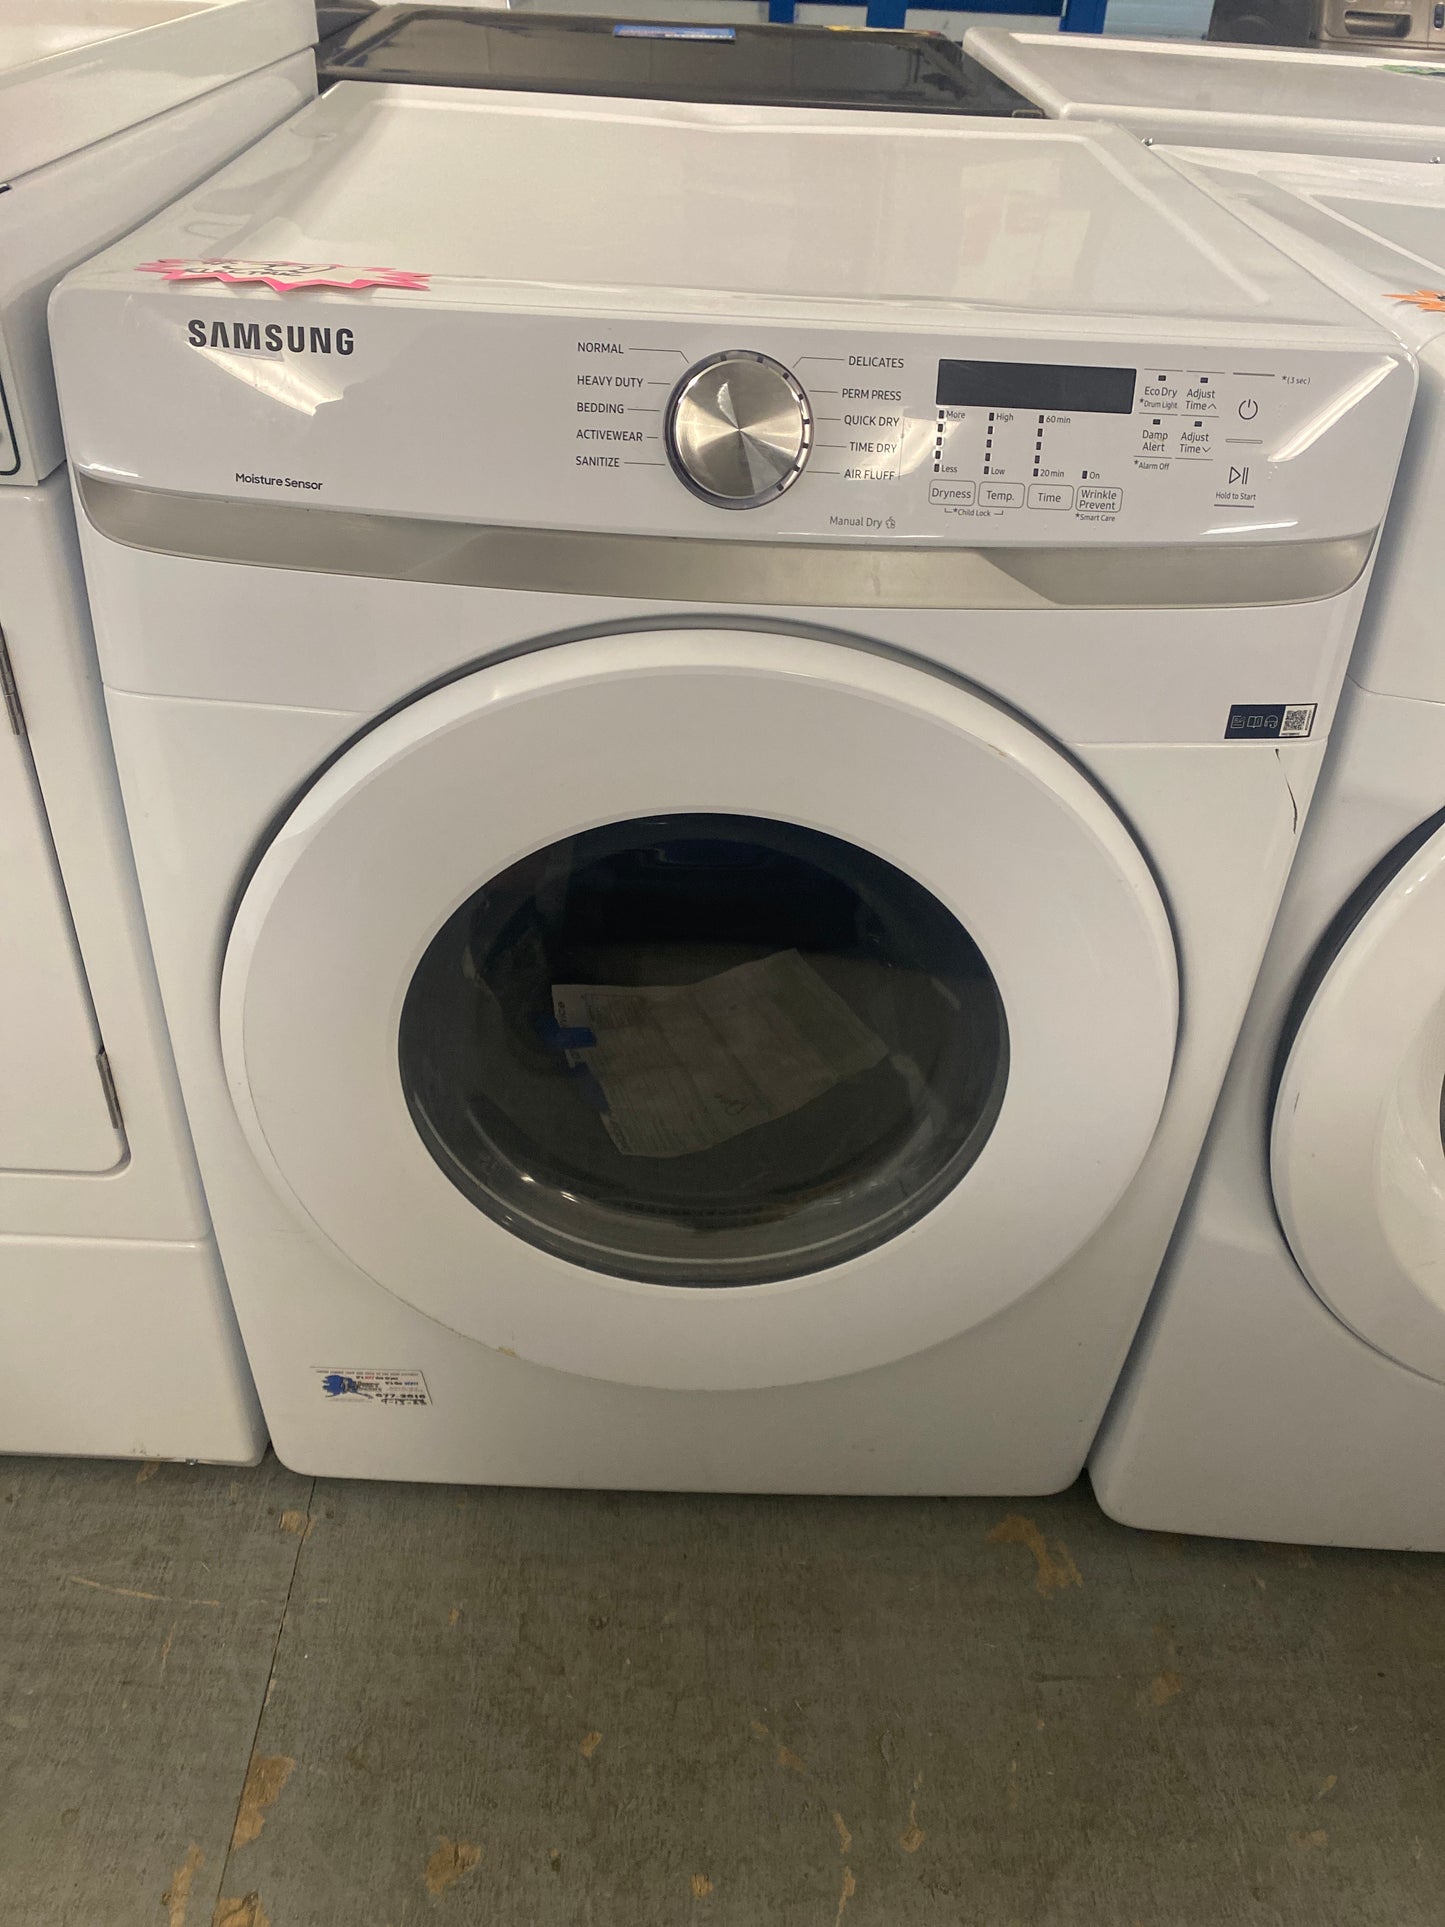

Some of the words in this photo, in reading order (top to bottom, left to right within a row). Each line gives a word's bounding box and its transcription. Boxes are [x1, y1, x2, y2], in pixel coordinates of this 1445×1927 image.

[188, 319, 354, 355] SAMSUNG
[577, 342, 624, 354] NORMAL
[848, 355, 905, 369] DELICATES
[576, 375, 613, 386] HEAVY
[615, 376, 644, 388] DUTY
[841, 388, 870, 400] PERM
[871, 390, 902, 401] PRESS
[1144, 386, 1160, 397] Eco
[1161, 387, 1178, 399] Dry
[1186, 388, 1216, 400] Adjust
[576, 402, 625, 414] BEDDING
[1162, 400, 1178, 410] Light
[1185, 400, 1207, 411] Time
[844, 414, 877, 426] QUICK
[878, 416, 900, 427] DRY
[945, 410, 966, 420] More
[996, 413, 1014, 423] High
[1045, 415, 1057, 424] 60
[1058, 416, 1071, 424] min
[576, 429, 643, 442] ACTIVEWEAR
[1142, 429, 1168, 442] Damp
[1180, 431, 1209, 443] Adjust
[849, 441, 874, 453] TIME
[876, 443, 897, 454] DRY
[1142, 441, 1165, 452] Alert
[1179, 443, 1201, 454] Time
[575, 456, 620, 468] SANITIZE
[1159, 462, 1170, 471] Off
[843, 468, 862, 480] AIR
[864, 469, 896, 481] FLUFF
[941, 464, 958, 474] Less
[991, 467, 1006, 475] Low
[1040, 468, 1050, 478] 20
[1051, 470, 1065, 478] min
[235, 473, 283, 486] Moisture
[284, 478, 323, 490] Sensor
[1089, 471, 1101, 480] On
[931, 486, 972, 500] Dryness
[986, 490, 1015, 502] Temp.
[1038, 492, 1062, 503] Time
[1081, 489, 1117, 501] Wrinkle
[1215, 491, 1230, 500] Hold
[1232, 492, 1239, 500] to
[1240, 492, 1257, 501] Start
[1079, 499, 1116, 511] Prevent
[975, 509, 991, 517] Lock
[1101, 514, 1115, 522] Care
[829, 515, 864, 527] Manual
[866, 517, 882, 529] Dry
